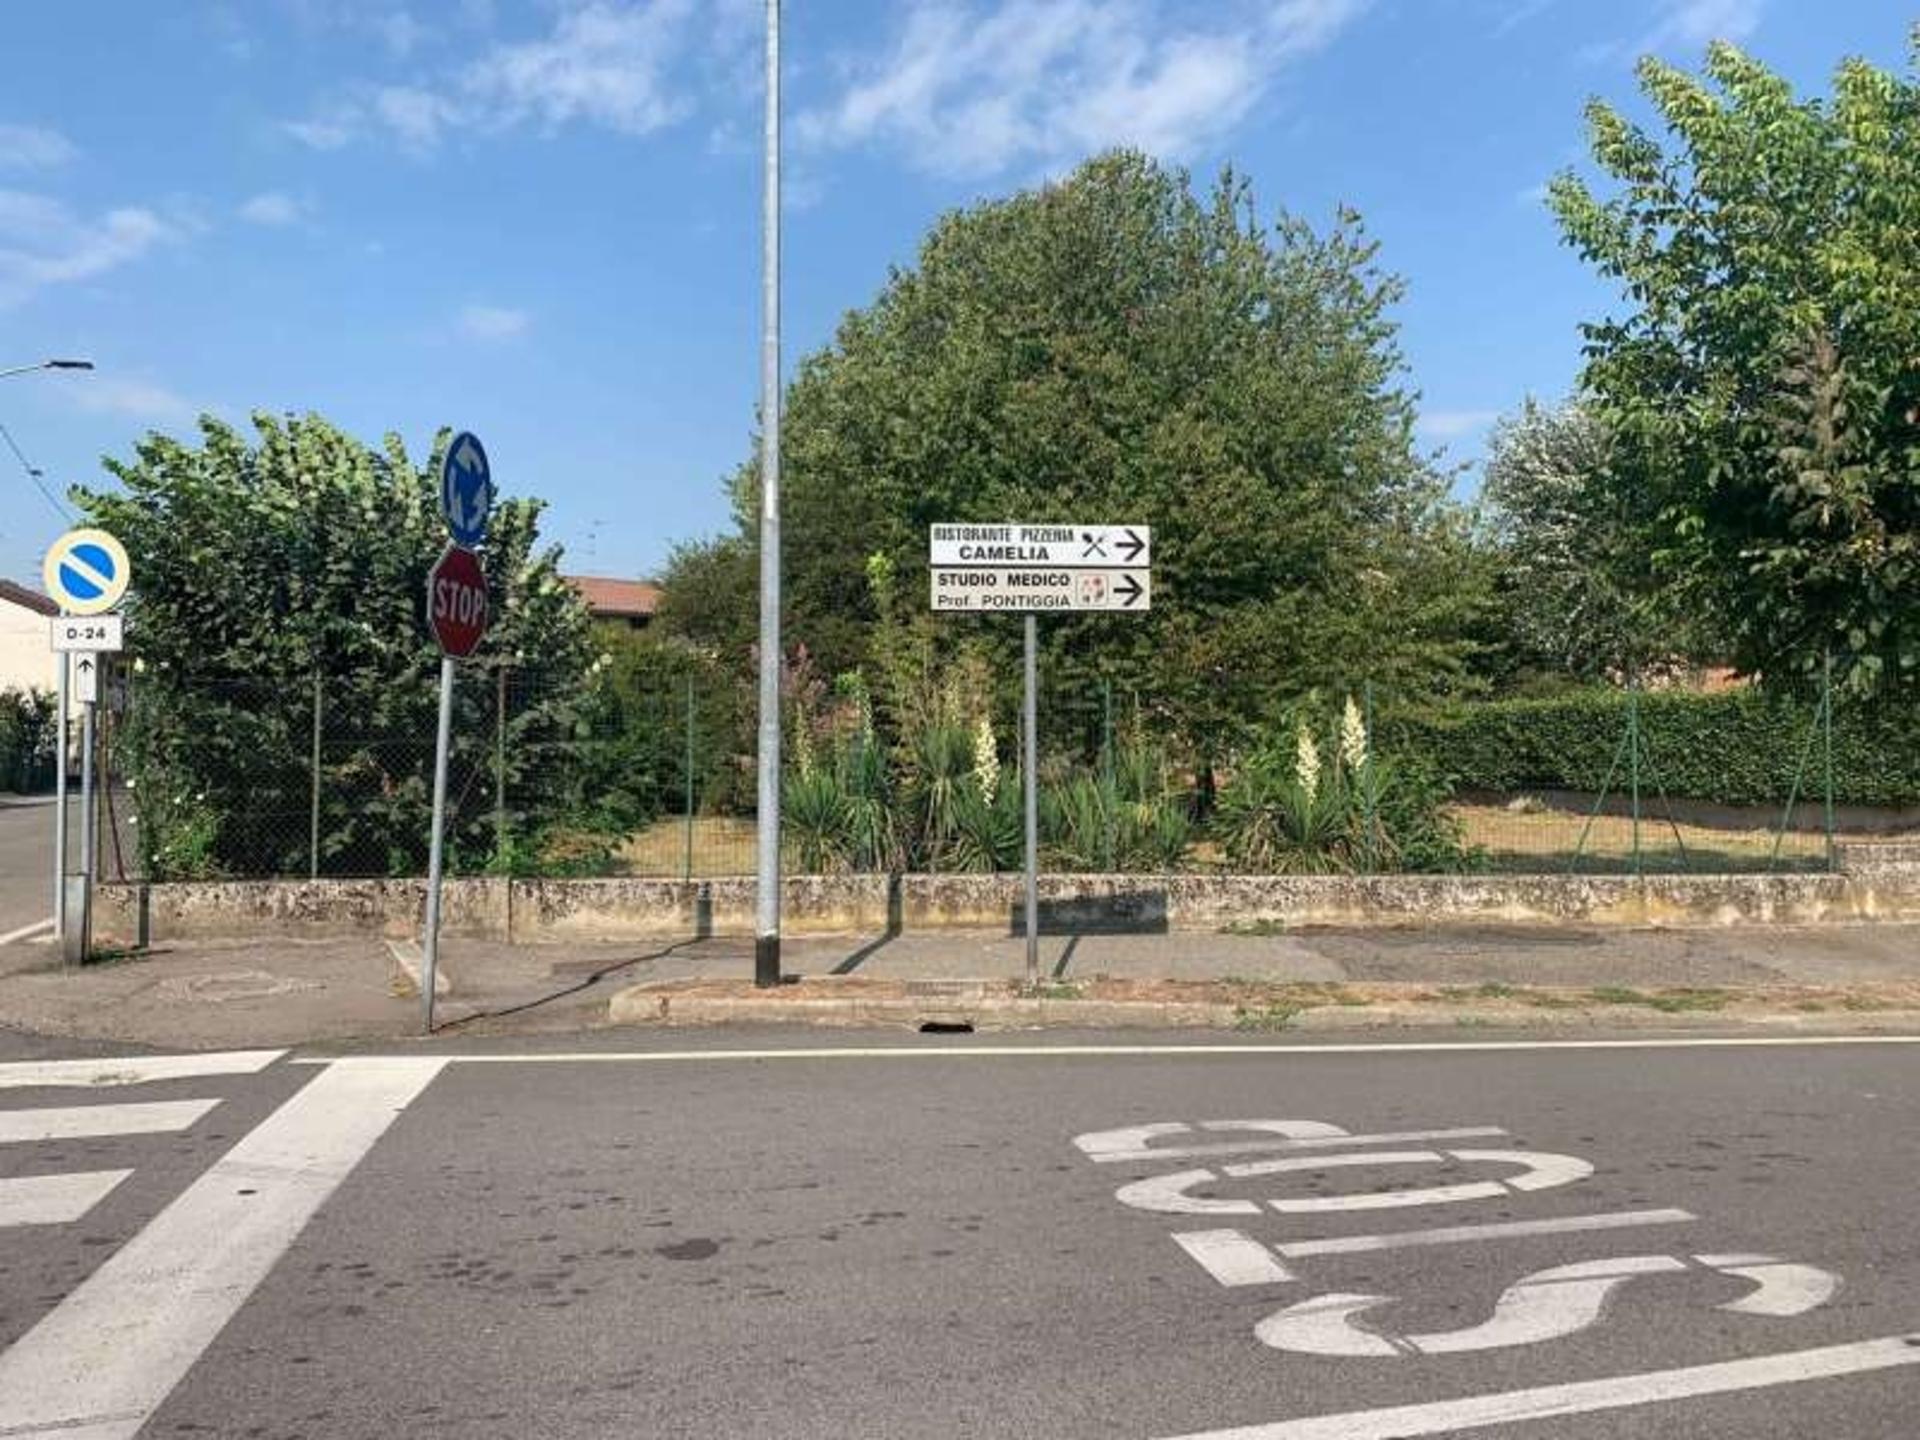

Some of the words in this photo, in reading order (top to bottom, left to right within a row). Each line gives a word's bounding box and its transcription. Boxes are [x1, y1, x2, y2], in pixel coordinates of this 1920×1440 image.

[933, 527, 1010, 541] RISTORANTE
[1021, 528, 1074, 542] PIZZERIA
[959, 546, 1050, 560] CAMELIA
[938, 573, 997, 587] STUDIO
[1007, 573, 1071, 587] MEDICO
[436, 578, 484, 626] STOP
[982, 594, 1071, 607] PONTIGGIA
[1073, 1119, 1844, 1357] STOP
